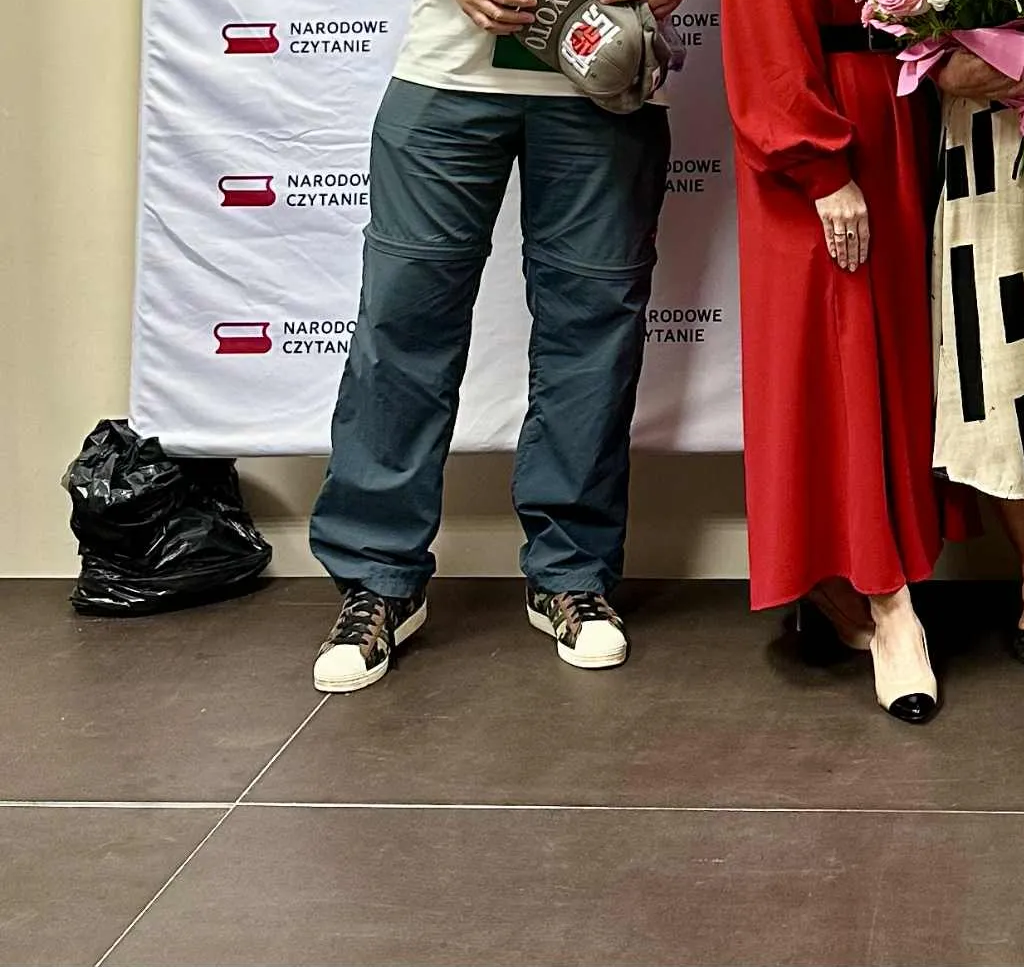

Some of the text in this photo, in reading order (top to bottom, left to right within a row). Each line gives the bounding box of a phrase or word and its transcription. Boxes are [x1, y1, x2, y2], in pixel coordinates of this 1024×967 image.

[291, 21, 388, 35] NARODOWE
[290, 40, 370, 53] CZYTANIE
[287, 193, 368, 206] CZYTANIE
[649, 309, 722, 322] RODOWE
[284, 321, 357, 334] NARODO
[645, 329, 704, 342] YTANIE
[283, 341, 348, 354] CZYTAN
